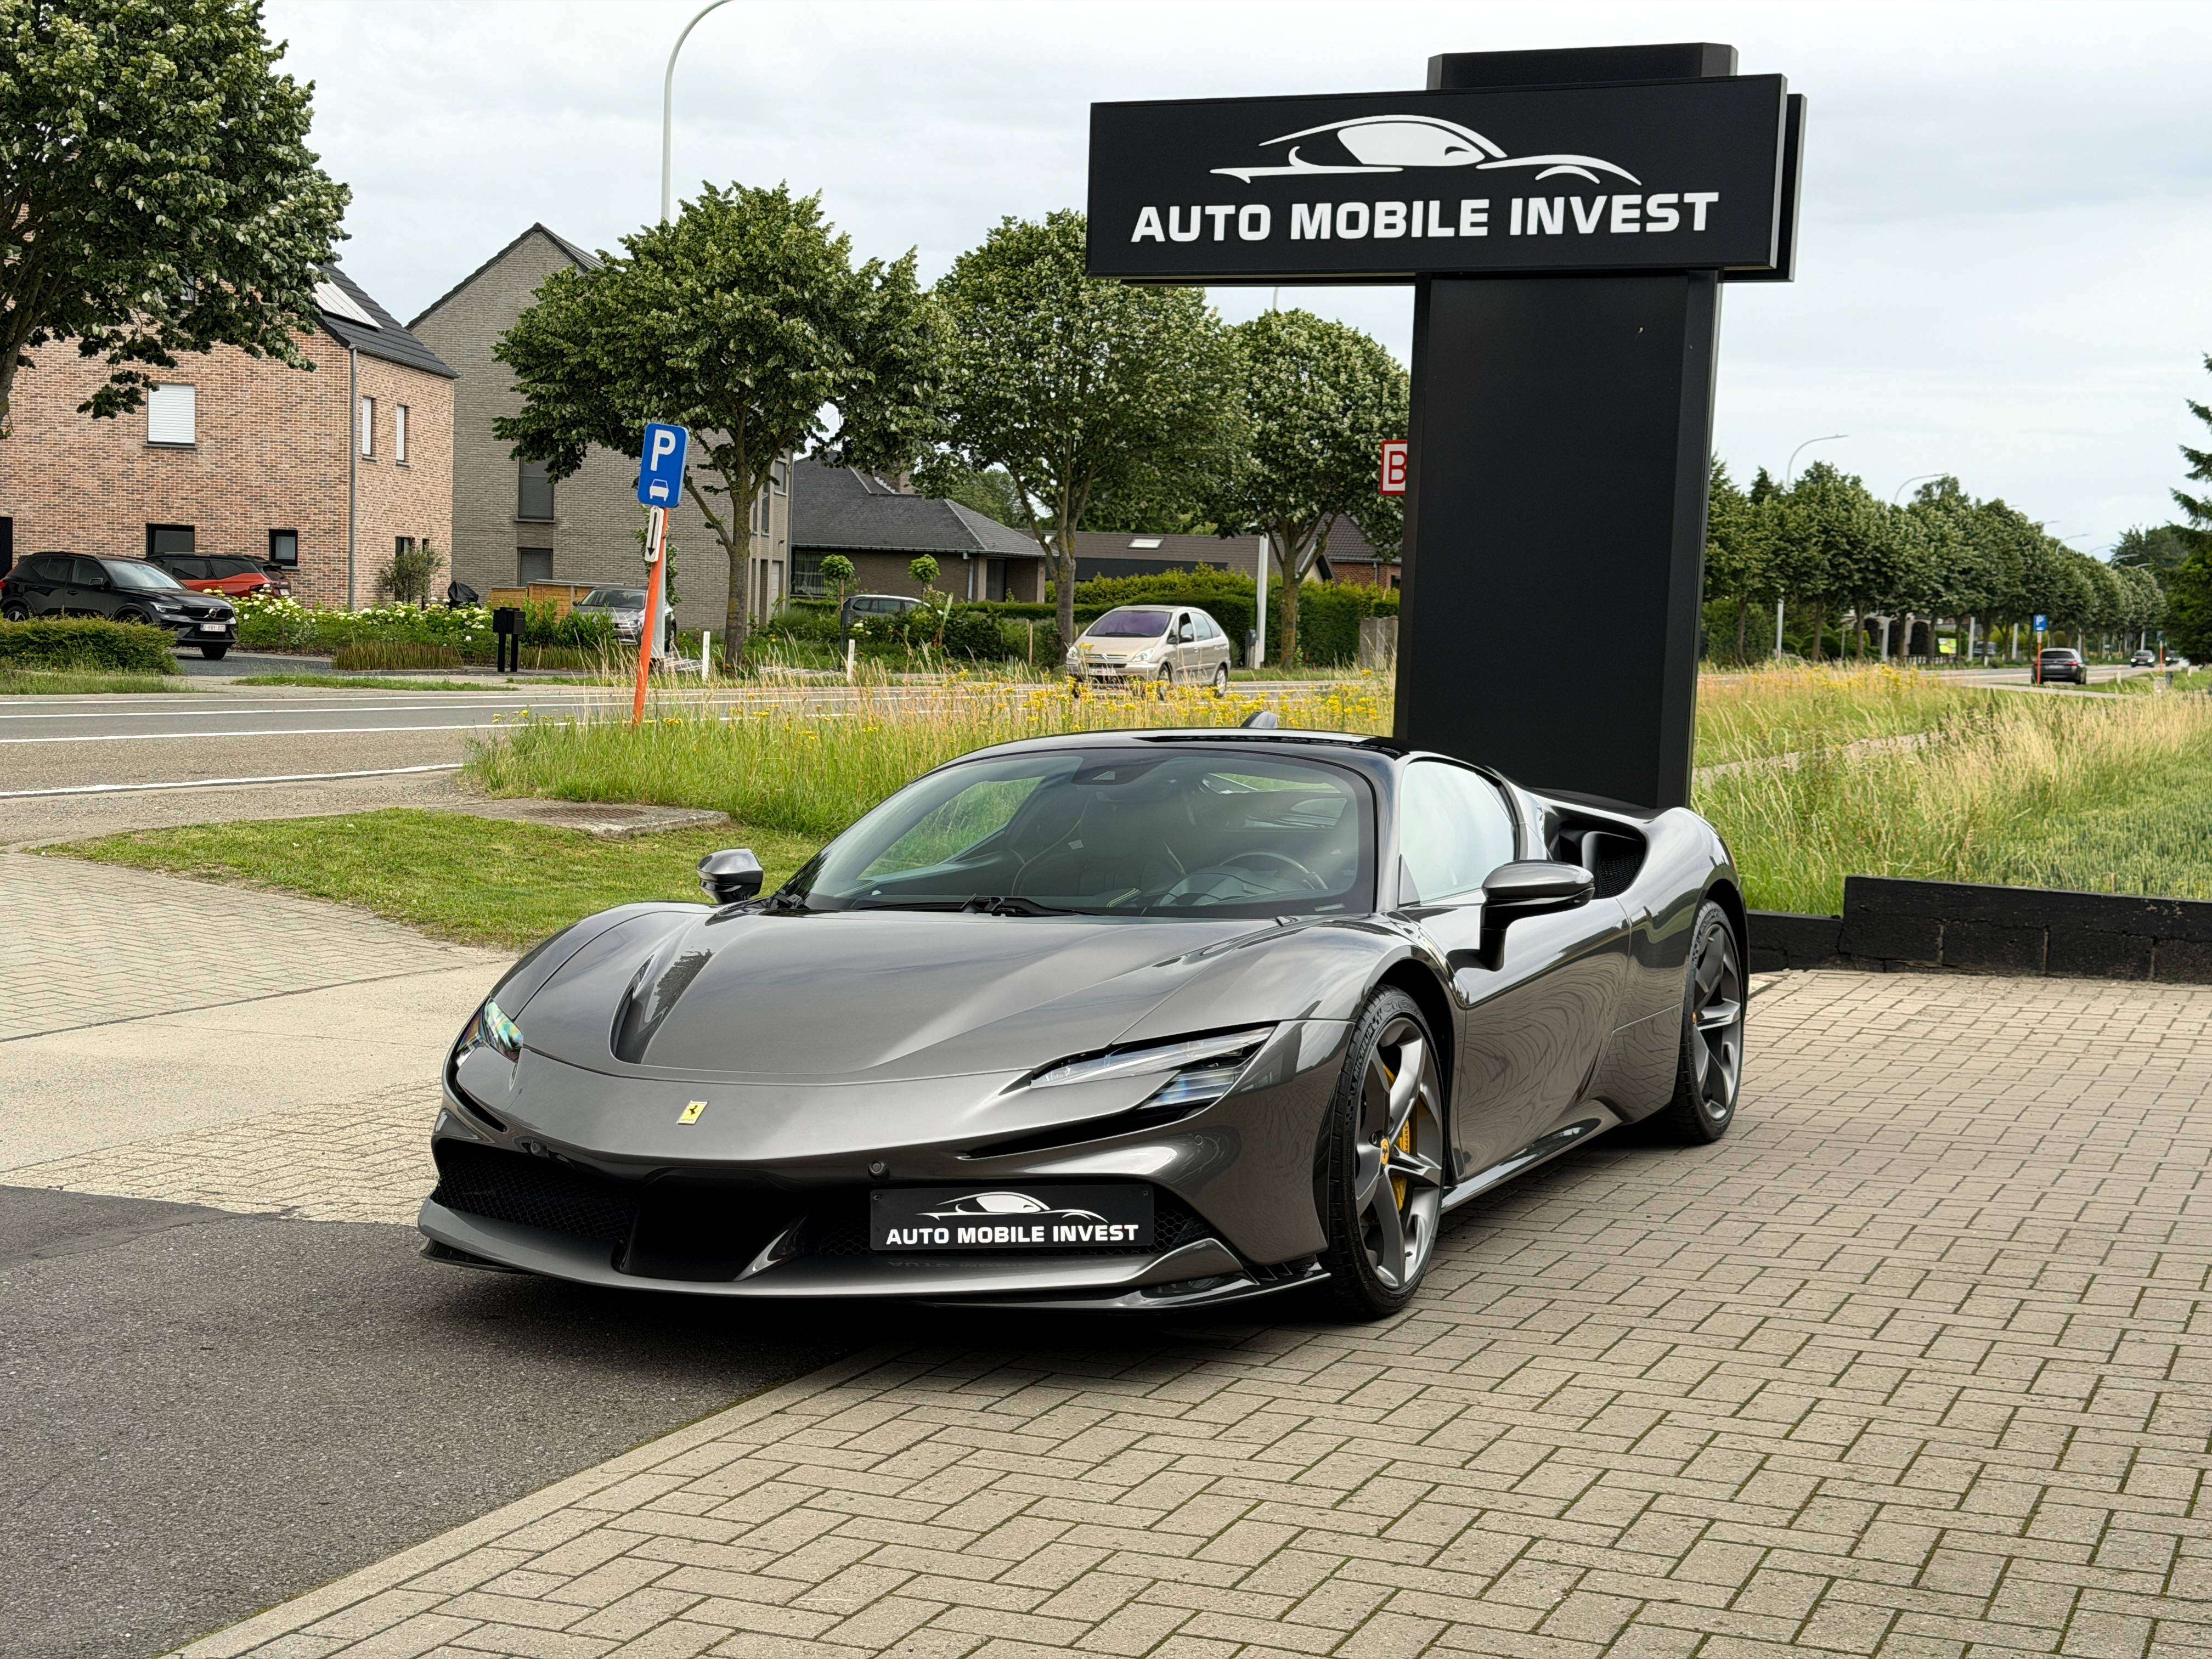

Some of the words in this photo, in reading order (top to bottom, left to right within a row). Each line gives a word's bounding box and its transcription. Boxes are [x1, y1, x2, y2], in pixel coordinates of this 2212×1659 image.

[1131, 204, 1271, 242] AUTO
[1290, 199, 1489, 240] MOBILE
[1510, 191, 1719, 235] INVEST
[650, 429, 676, 471] P
[2035, 616, 2044, 625] P
[1353, 1023, 1374, 1080] MICHELIN
[885, 1228, 949, 1245] AUTO
[957, 1226, 1045, 1244] MOBILE
[1053, 1224, 1139, 1242] INVEST
